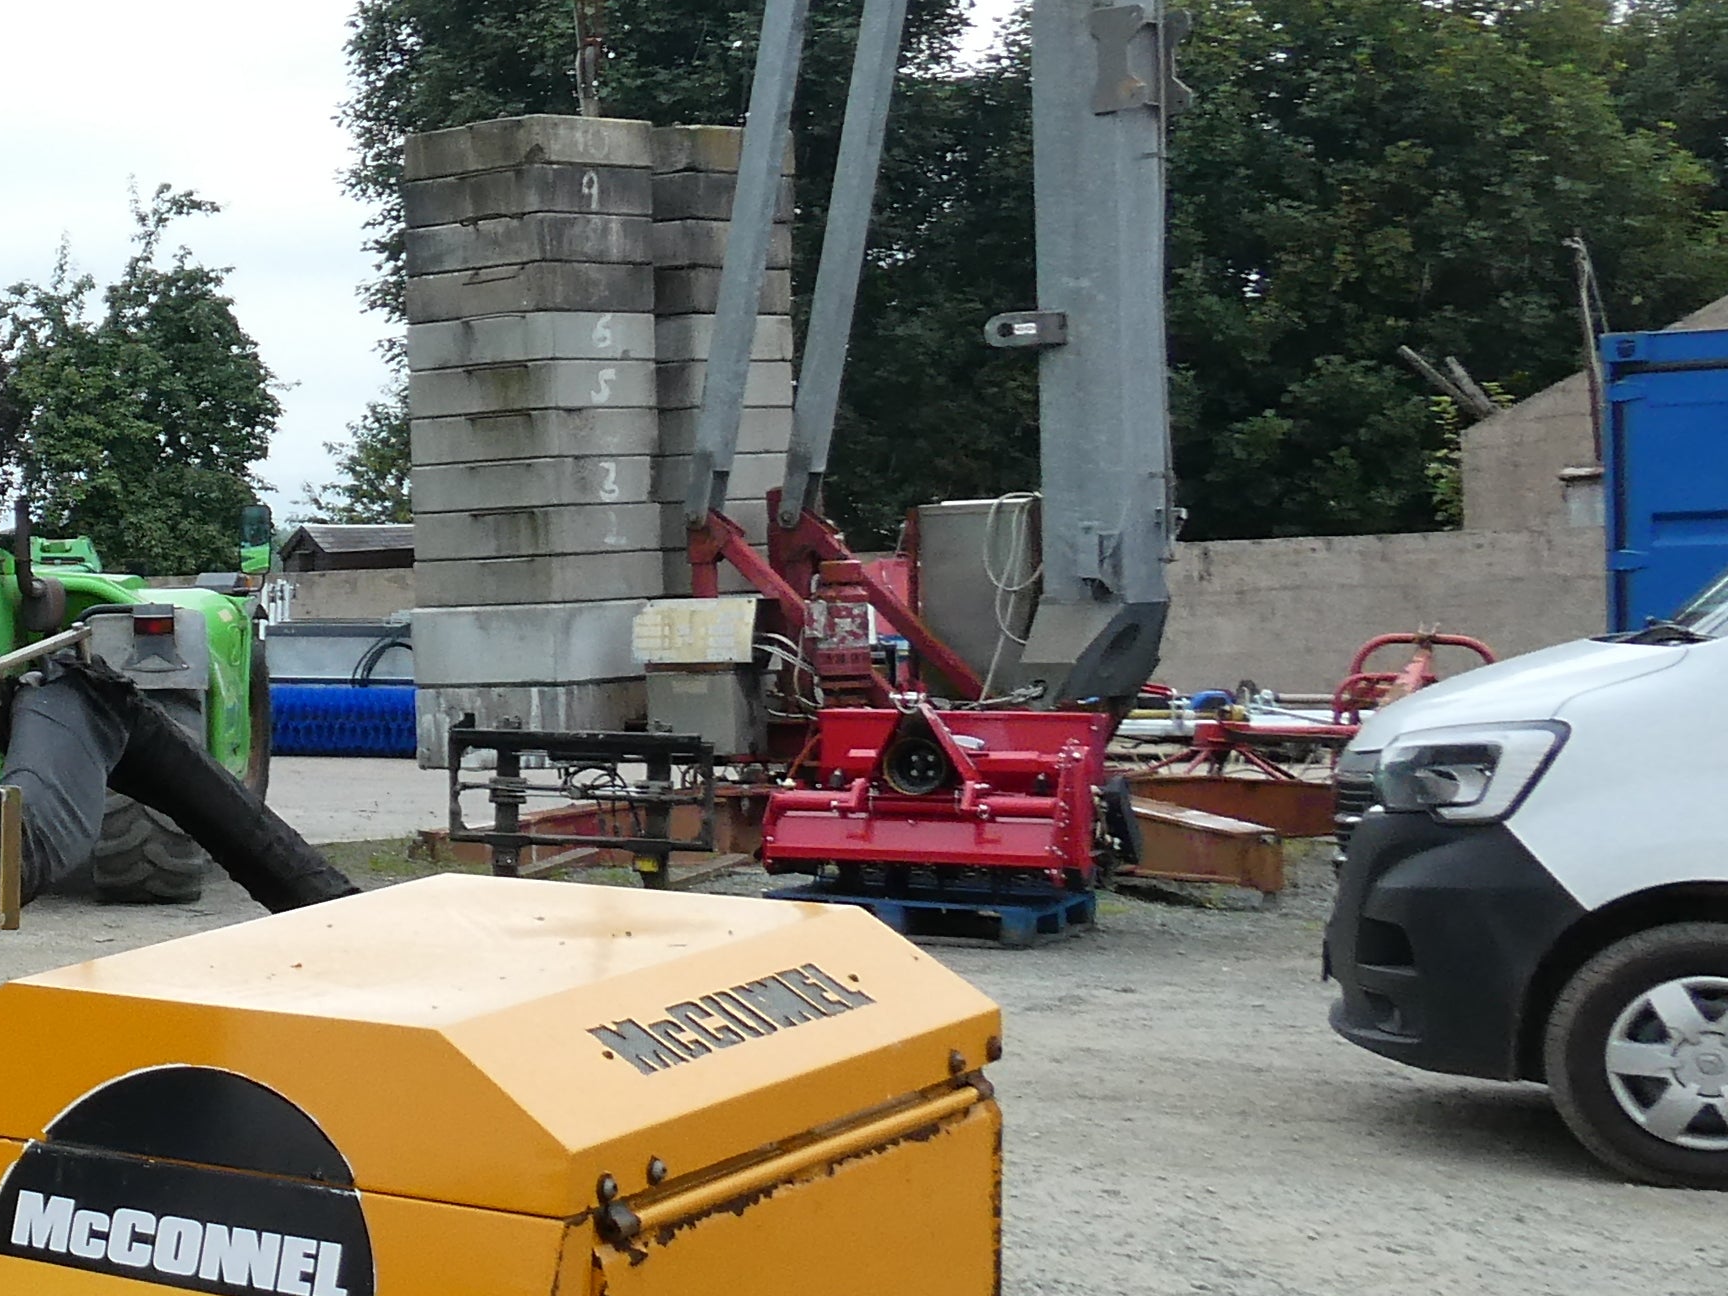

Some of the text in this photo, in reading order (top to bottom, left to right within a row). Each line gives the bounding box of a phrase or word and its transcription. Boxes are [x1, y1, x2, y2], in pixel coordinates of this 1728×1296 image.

[582, 170, 598, 209] 9
[593, 312, 613, 348] 6
[591, 368, 616, 403] 5
[600, 462, 619, 502] 3
